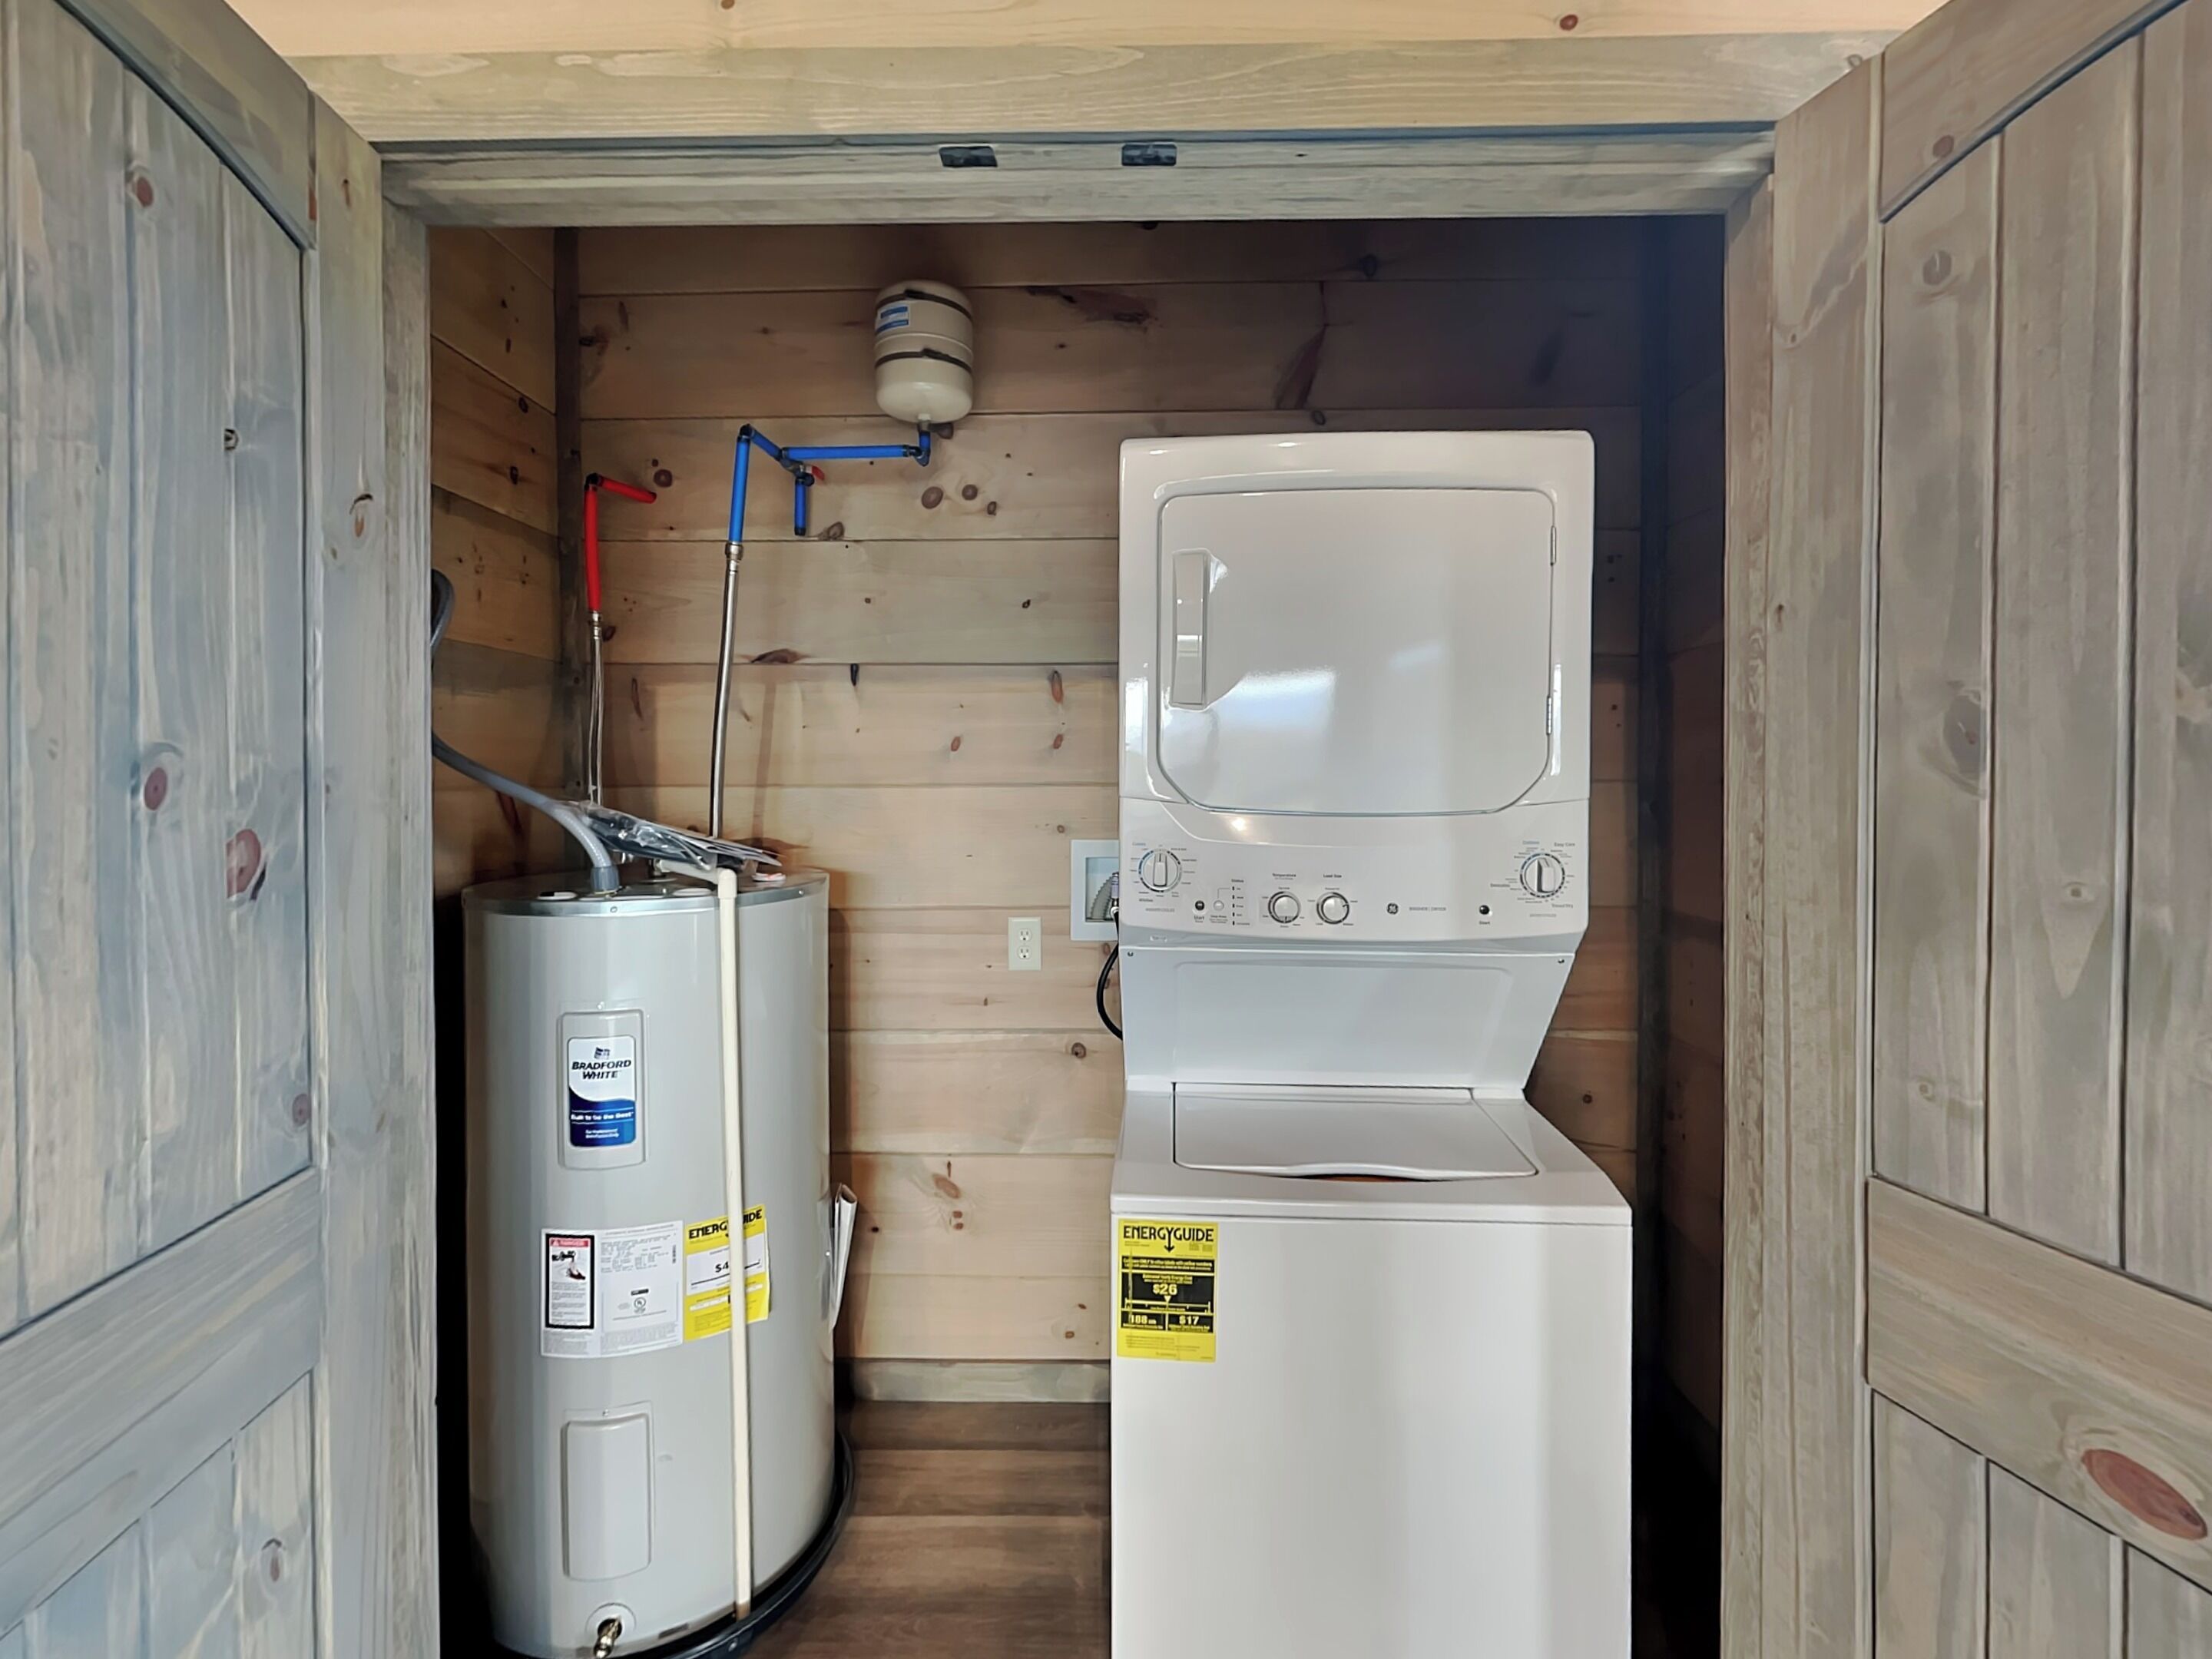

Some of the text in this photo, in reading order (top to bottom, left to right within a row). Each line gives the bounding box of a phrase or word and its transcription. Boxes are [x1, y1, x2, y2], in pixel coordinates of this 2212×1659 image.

[571, 1059, 632, 1071] BRADFORD
[582, 1070, 618, 1080] WHITE
[1123, 1225, 1214, 1243] ENERGYGUIDE
[1152, 1283, 1178, 1296] $26
[1179, 1315, 1200, 1325] $17
